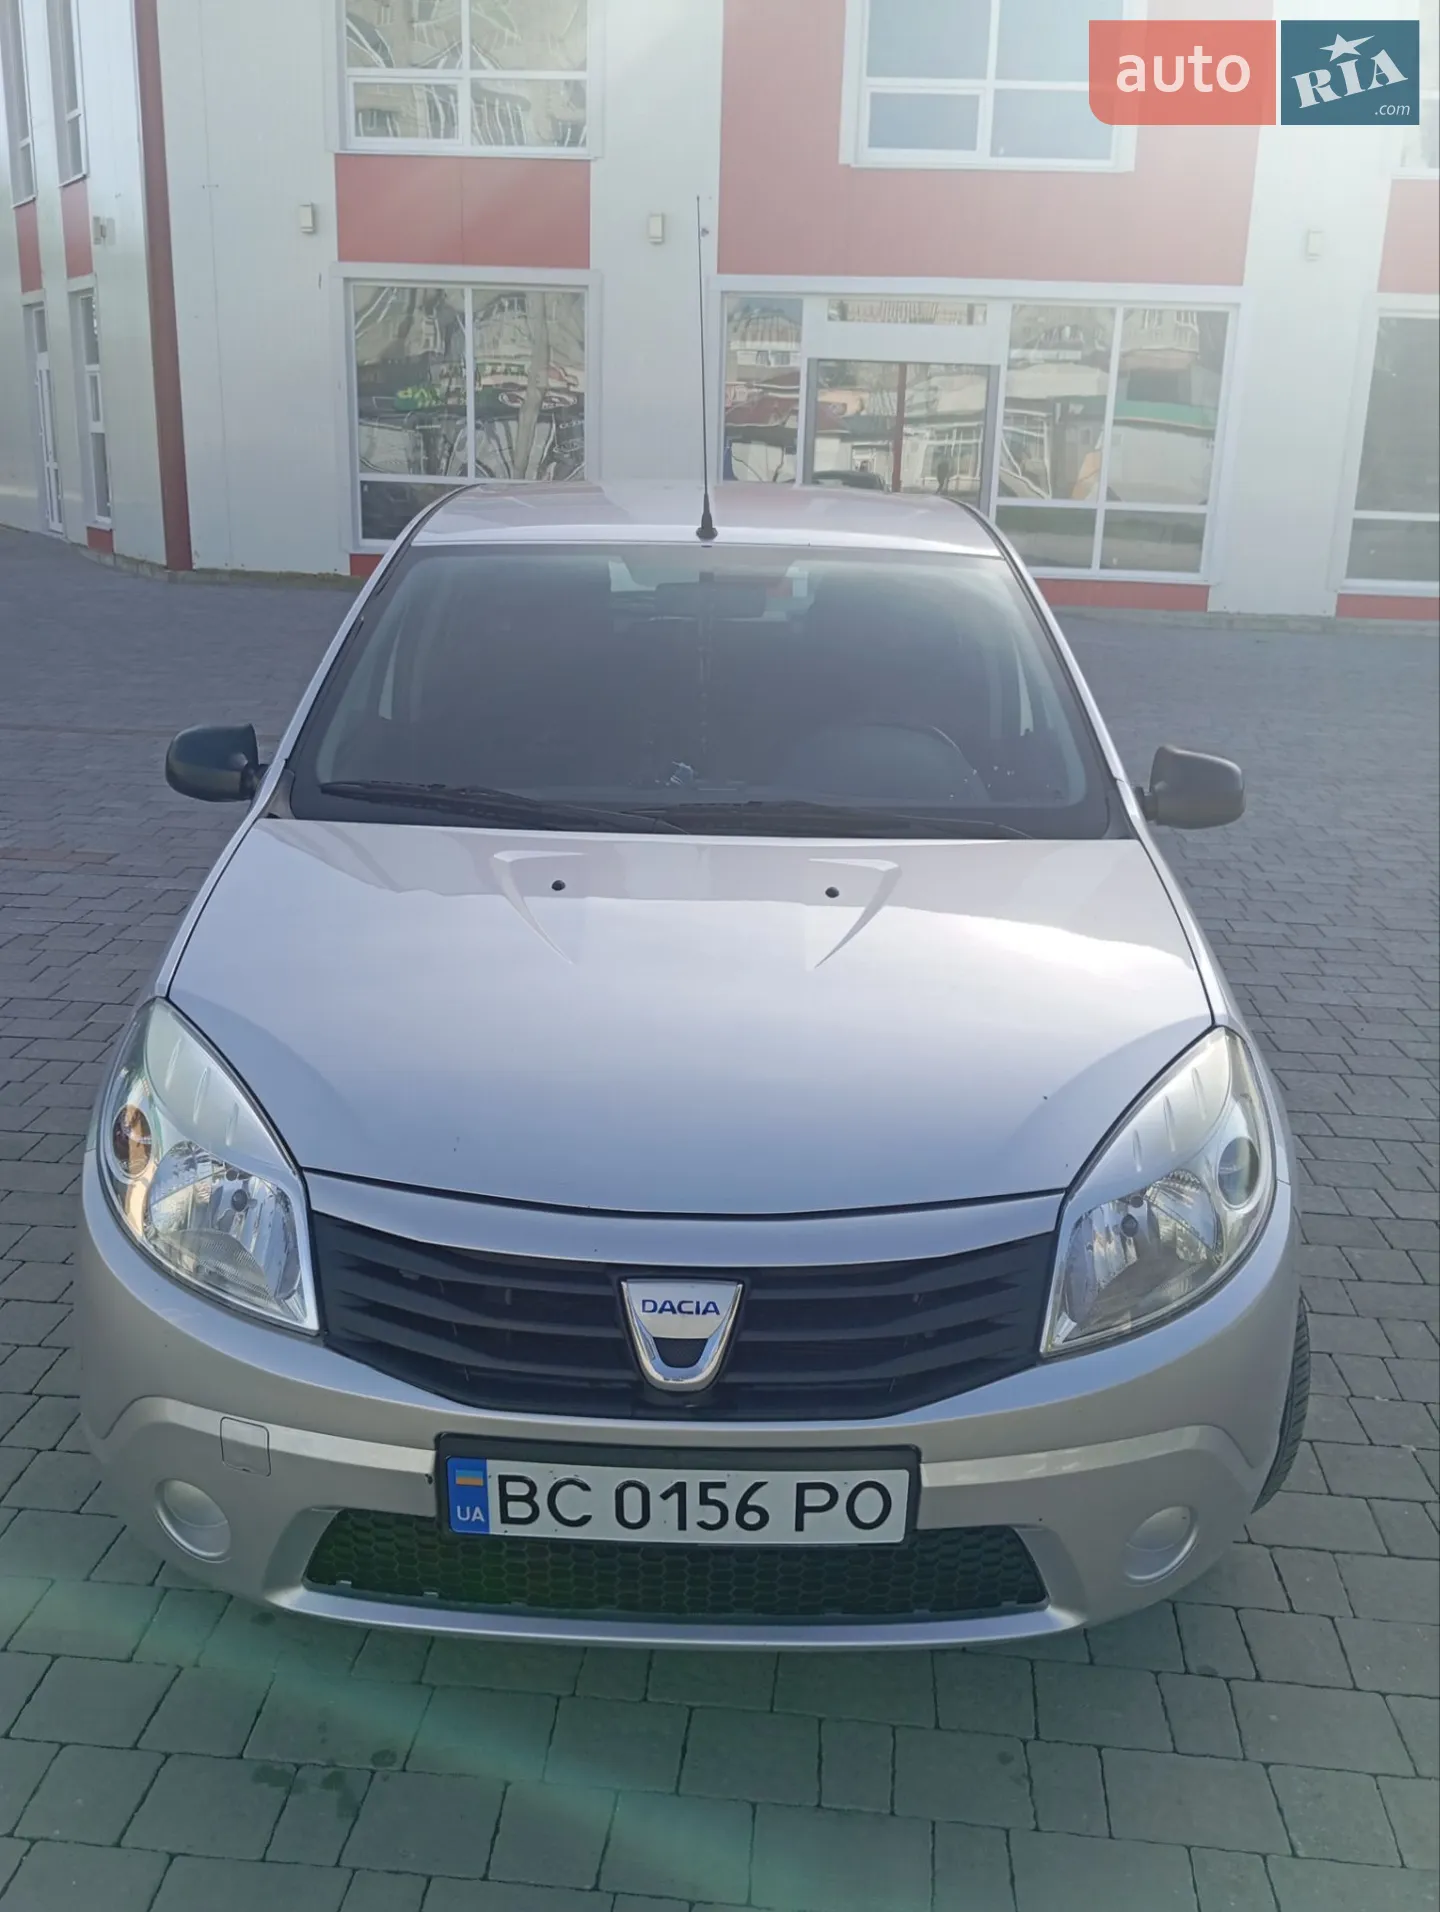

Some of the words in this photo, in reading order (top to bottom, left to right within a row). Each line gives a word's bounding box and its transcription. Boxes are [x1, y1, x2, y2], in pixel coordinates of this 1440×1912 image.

[641, 1299, 720, 1315] DACIA
[498, 1474, 593, 1528] BC
[614, 1480, 770, 1531] 0156
[794, 1480, 893, 1531] PO
[456, 1505, 485, 1522] UA
